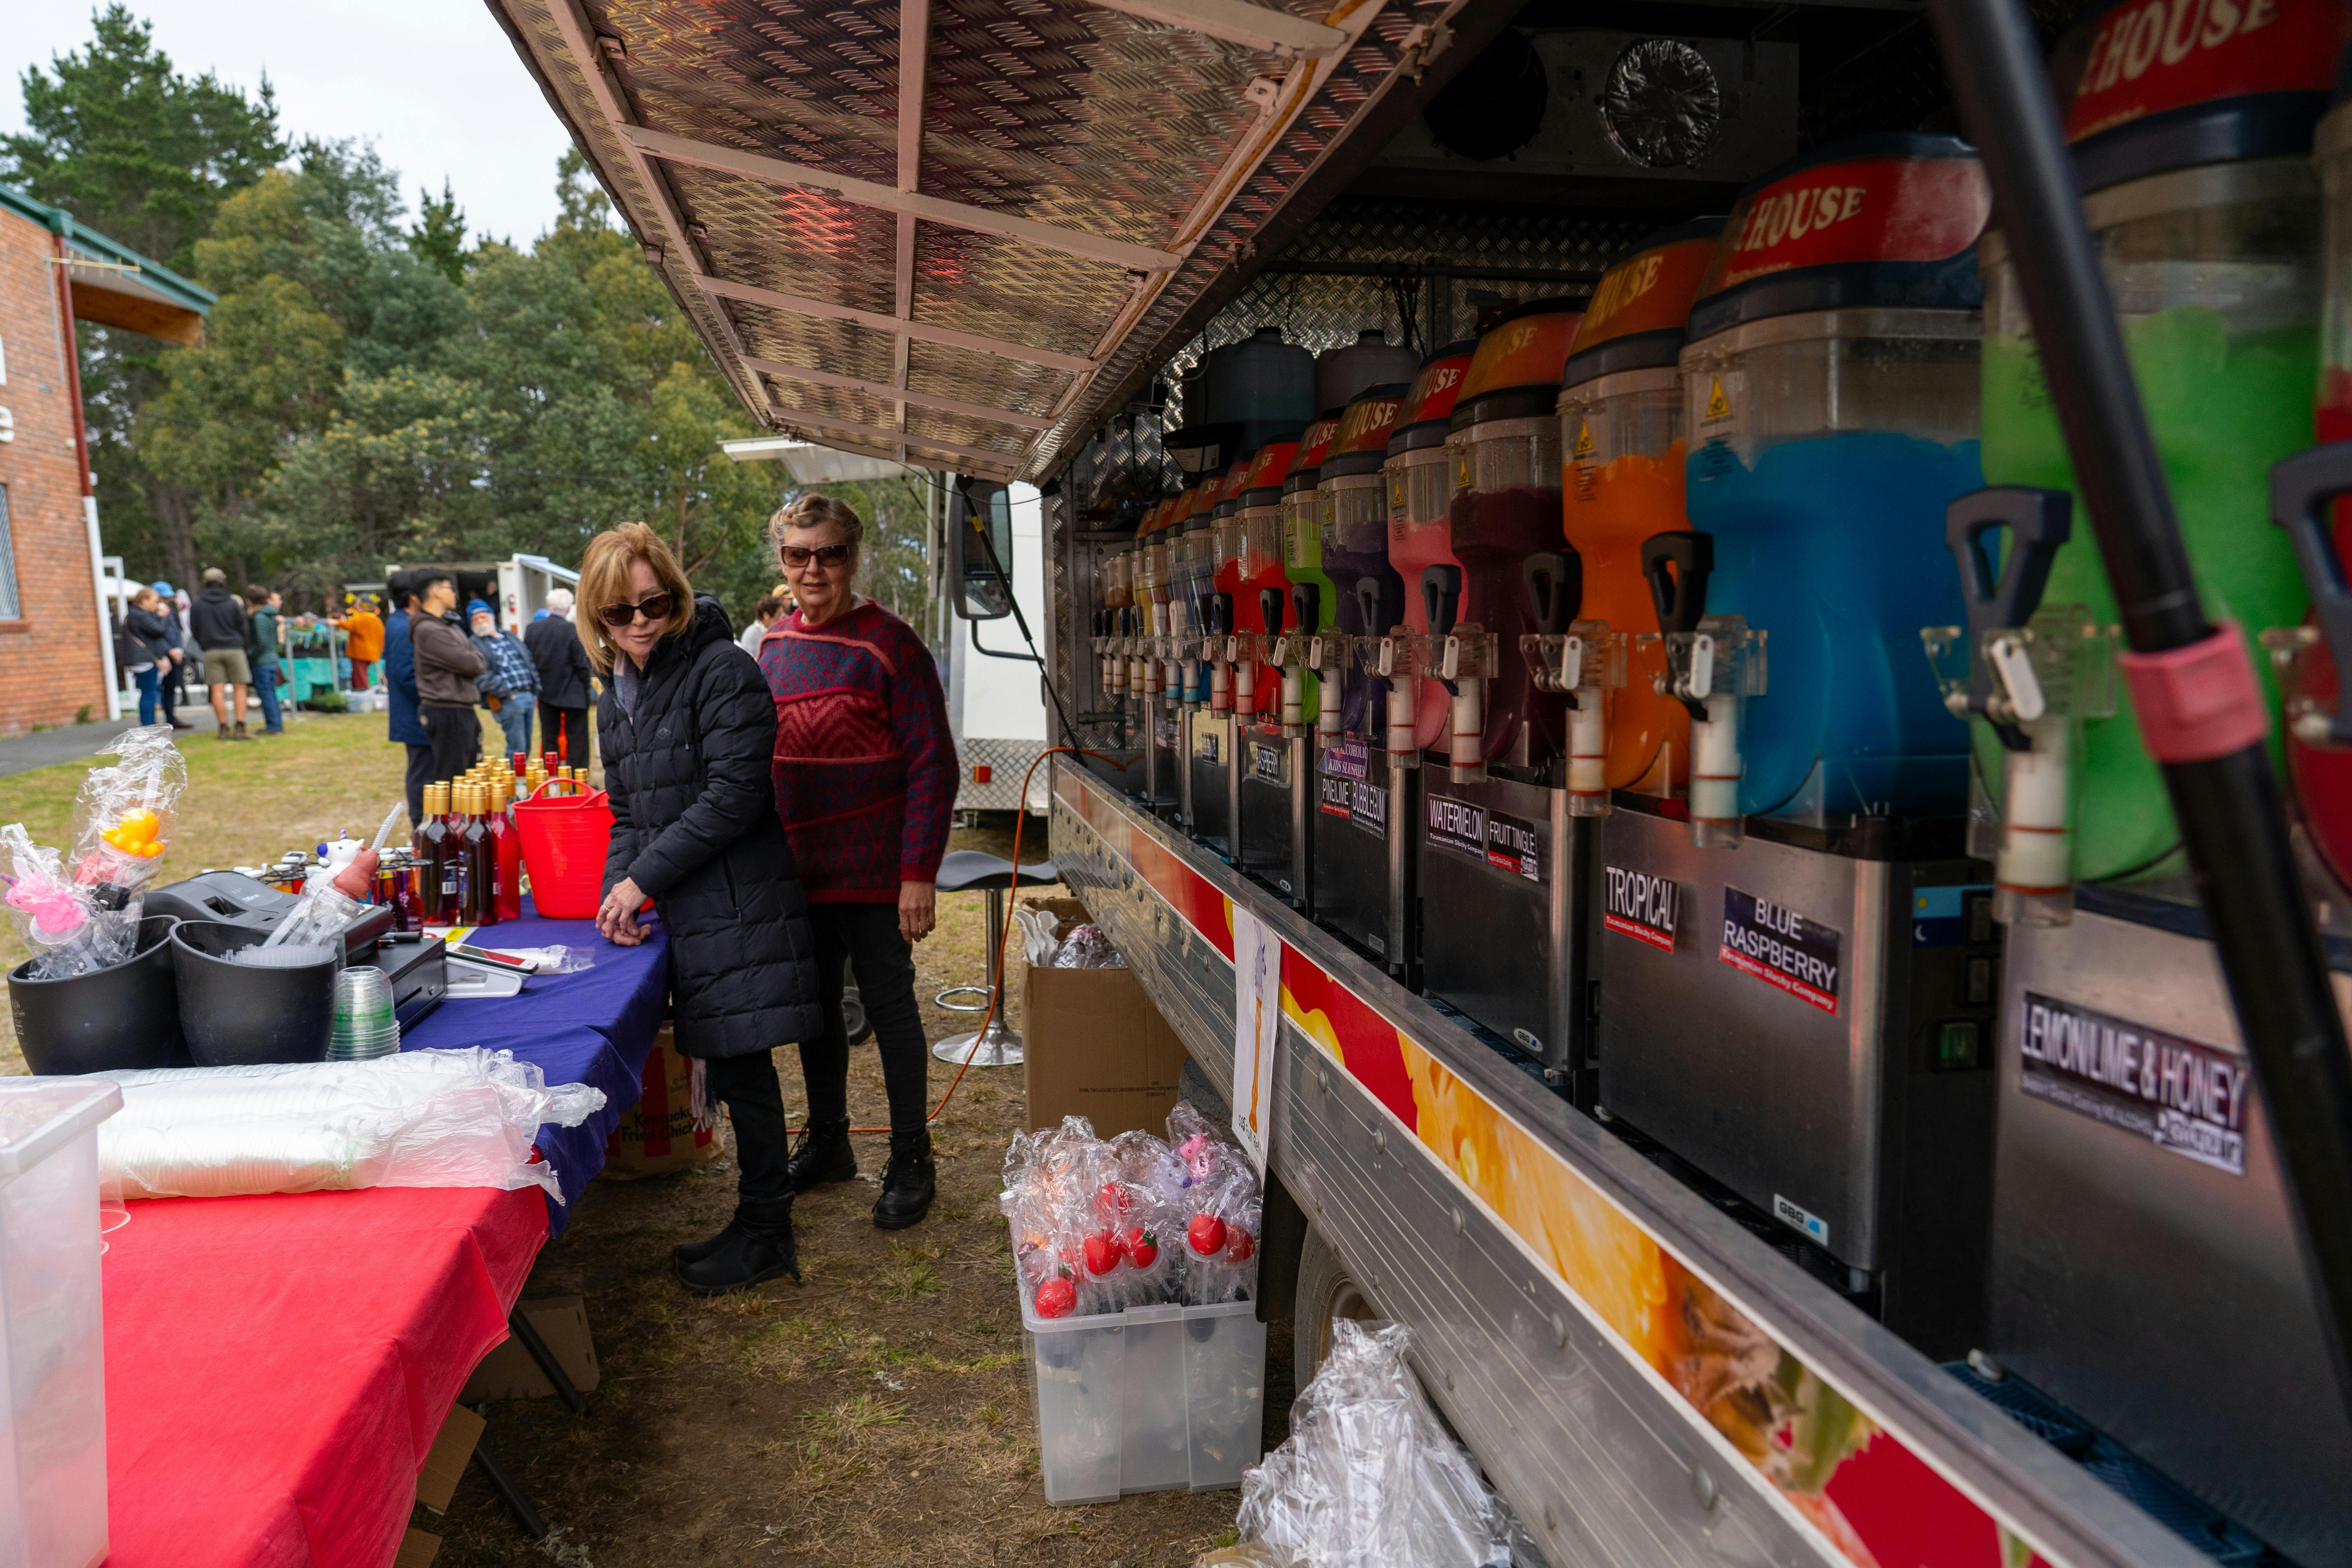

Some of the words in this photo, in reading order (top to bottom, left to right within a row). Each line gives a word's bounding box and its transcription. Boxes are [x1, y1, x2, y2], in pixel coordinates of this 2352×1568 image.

[1328, 759, 1341, 772] KIDS
[1342, 761, 1365, 778] SLUSHIES
[1353, 780, 1384, 824] BUBBLEGUM
[1353, 815, 1365, 824] Tasmanian
[1365, 819, 1373, 828] Slushy
[1374, 824, 1383, 834] Company
[1430, 799, 1483, 842] WATERMELON
[1490, 820, 1511, 846] FRUIT
[1511, 827, 1535, 856] TINGLE
[1430, 833, 1454, 844] Tasmanian
[1454, 840, 1467, 850] Slushy
[1467, 844, 1484, 857] Company
[1606, 866, 1673, 931] TROPICAL
[1755, 898, 1802, 941] BLUE
[1606, 916, 1633, 931] Tasmanian
[1723, 919, 1837, 991] RASPBERRY
[1721, 947, 1763, 975] Tasmanian
[1764, 968, 1791, 989] Slushy
[1792, 981, 1833, 1010] Company
[2140, 1040, 2157, 1101] &
[2160, 1045, 2249, 1129] HONEY
[620, 1125, 655, 1142] Fried
